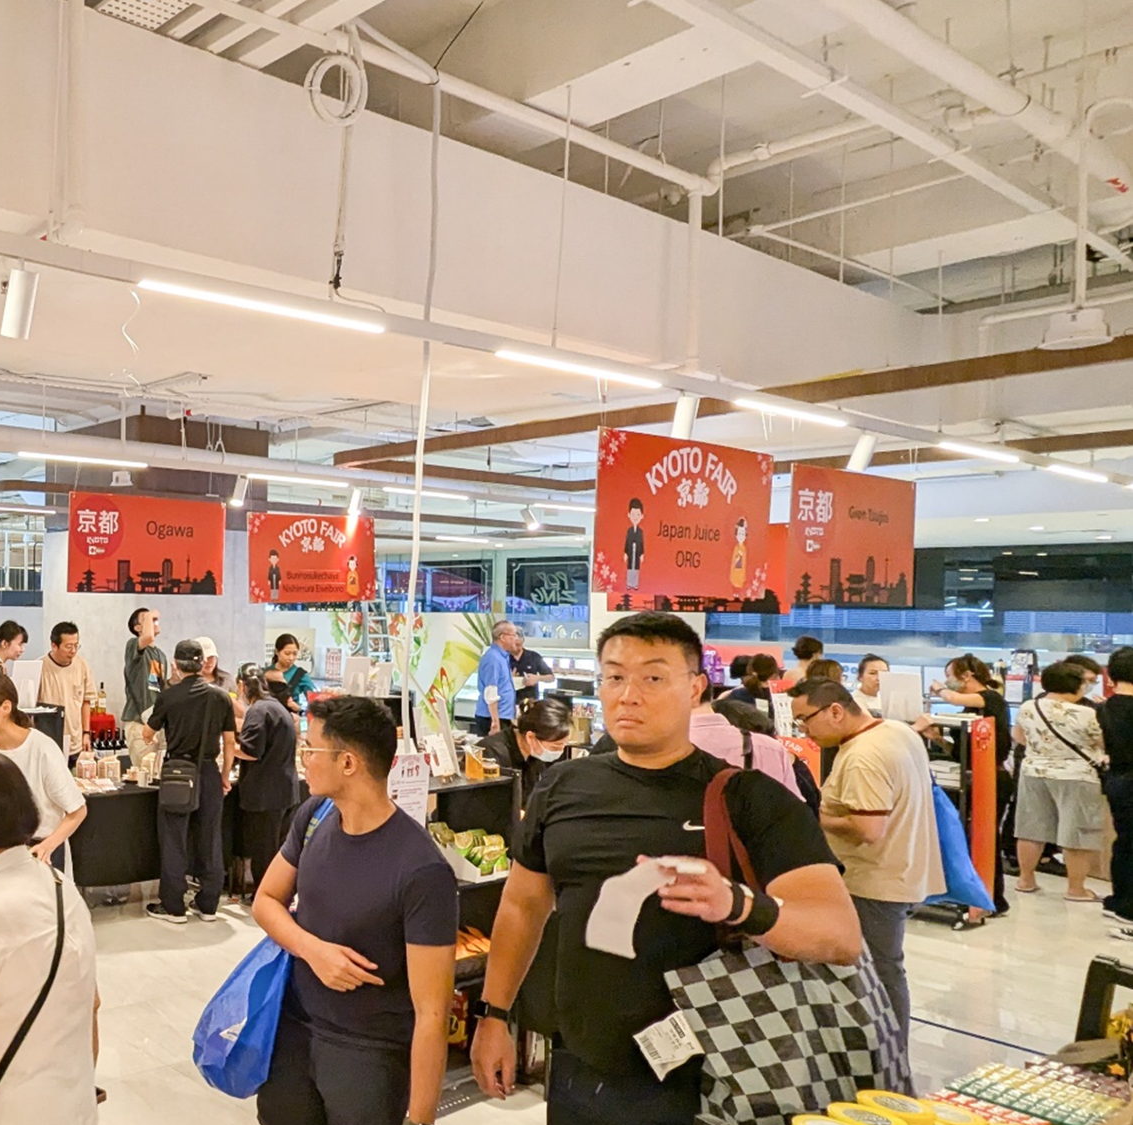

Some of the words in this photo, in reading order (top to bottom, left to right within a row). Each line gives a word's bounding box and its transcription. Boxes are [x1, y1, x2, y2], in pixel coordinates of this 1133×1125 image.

[644, 446, 704, 496] KYOTO
[705, 452, 738, 505] FAIR
[676, 477, 710, 510] 京都
[797, 488, 833, 523] 京都
[76, 508, 119, 535] 京都
[146, 520, 194, 540] Ogawa
[278, 519, 319, 548] KYOTO
[319, 521, 347, 549] FAIR
[657, 520, 691, 542] Japan
[692, 522, 721, 542] Juice
[675, 550, 701, 569] ORG
[784, 738, 804, 753] FAIR
